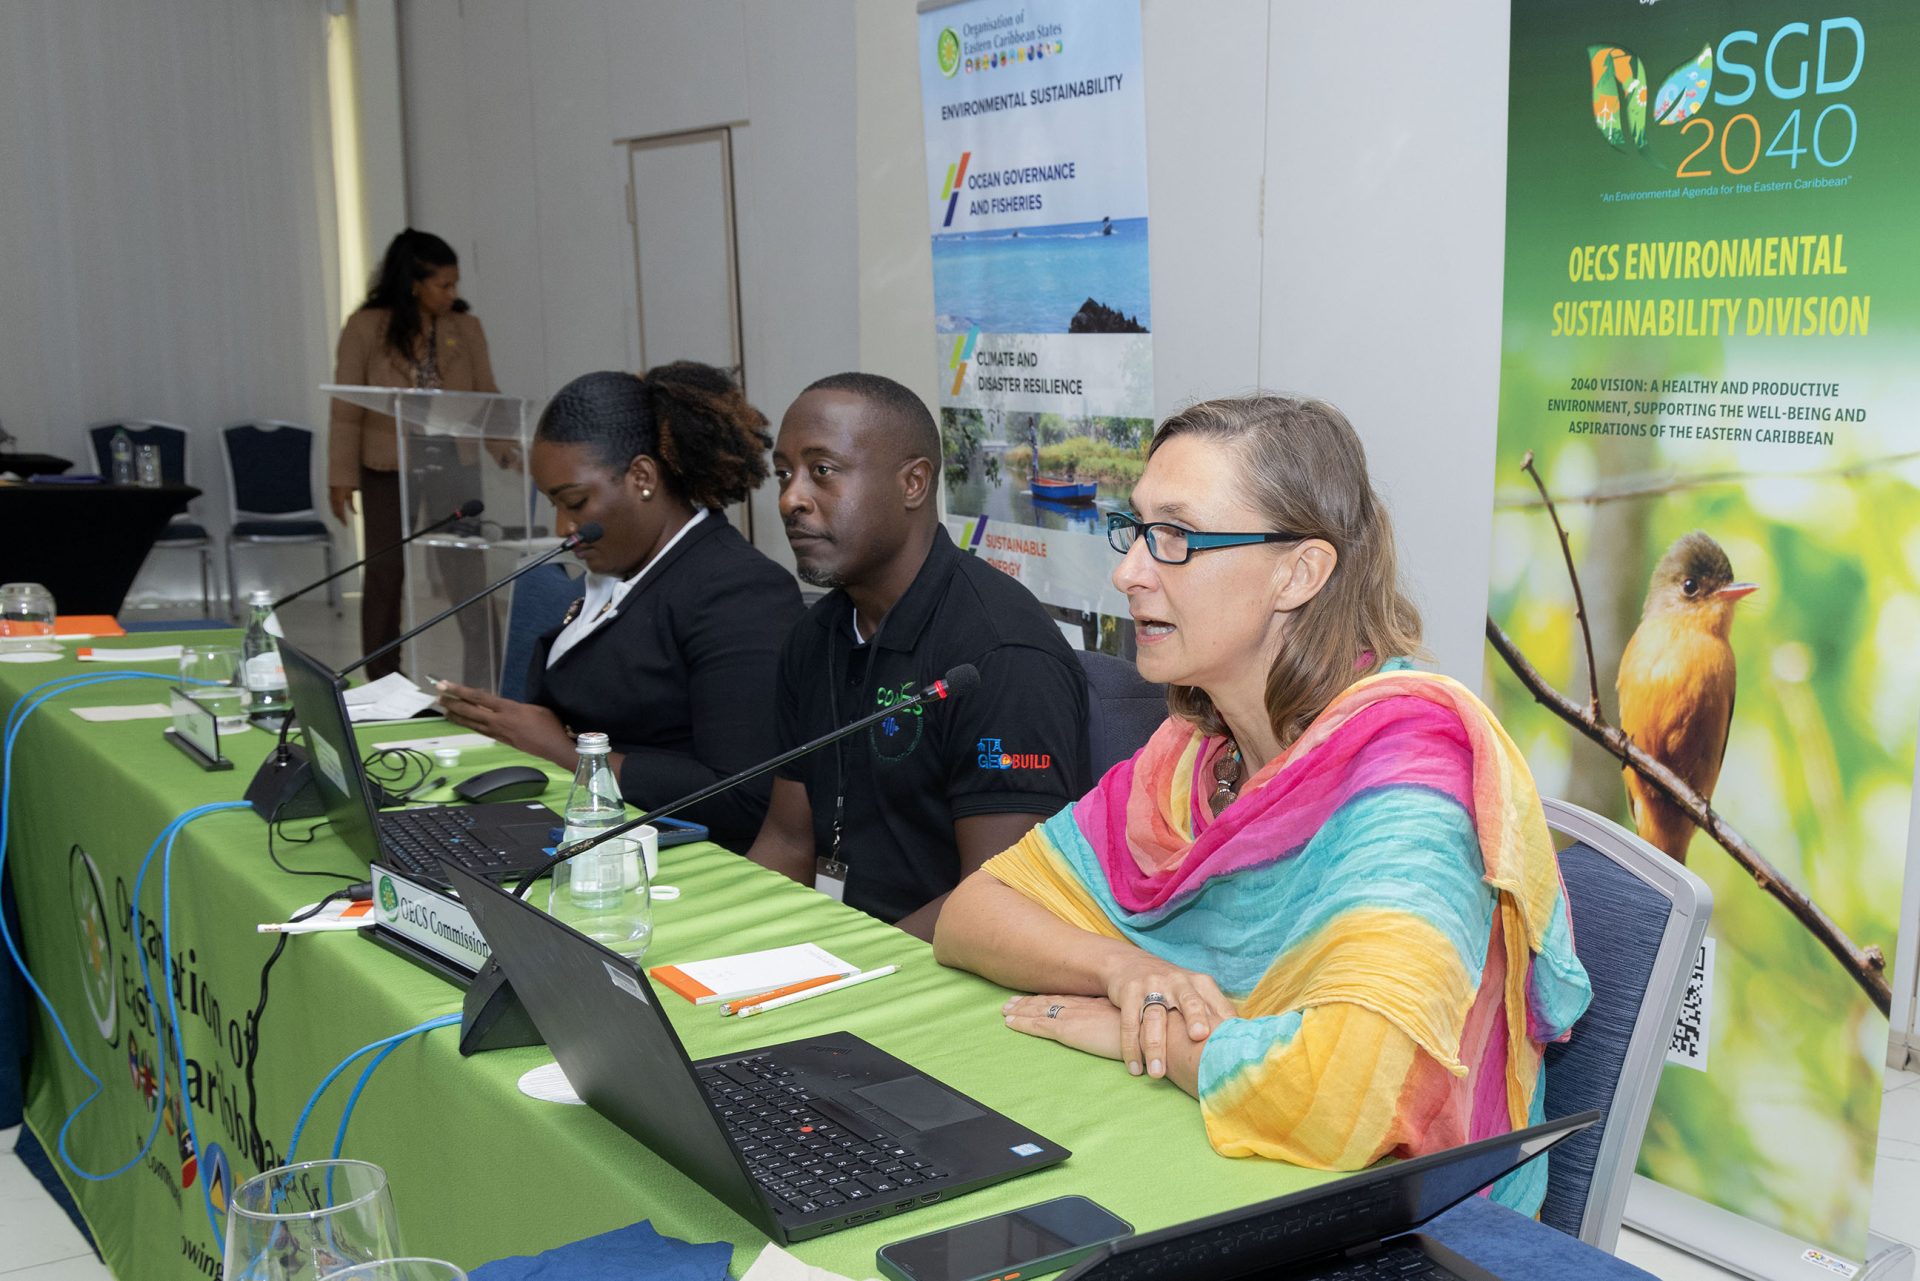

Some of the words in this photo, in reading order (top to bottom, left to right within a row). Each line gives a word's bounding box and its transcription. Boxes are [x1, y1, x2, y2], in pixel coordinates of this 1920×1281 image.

[963, 14, 1013, 39] Organisation
[1015, 8, 1025, 24] of
[963, 38, 991, 55] Eastern
[993, 29, 1035, 49] Caribbean
[1036, 23, 1063, 39] States
[1714, 16, 1865, 106] SGD
[941, 93, 1027, 121] ENVIRONMENTAL
[1030, 73, 1123, 105] SUSTAINABILITY
[1676, 103, 1857, 178] 2040
[968, 173, 1001, 190] OCEAN
[1002, 162, 1076, 186] GOVERNANCE
[969, 199, 990, 216] AND
[991, 194, 1043, 214] FISHERIES
[1615, 188, 1680, 202] Environmental
[1681, 186, 1718, 199] Agenda
[1720, 184, 1734, 195] for
[1736, 183, 1752, 193] the
[1753, 181, 1792, 193] Eastern
[1568, 243, 1620, 282] OECS
[1624, 233, 1848, 281] ENVIRONMENTAL
[1551, 297, 1743, 337] SUSTAINABILITY
[1745, 295, 1871, 337] DIVISION
[976, 351, 1015, 367] CLIMATE
[1016, 352, 1038, 367] AND
[978, 376, 1021, 392] DISASTER
[1023, 378, 1083, 395] RESILIENCE
[1570, 377, 1598, 391] 2040
[1600, 378, 1648, 392] VISION:
[1650, 379, 1659, 393] A
[1662, 380, 1718, 394] HEALTHY
[1720, 381, 1749, 395] AND
[1751, 381, 1840, 397] PRODUCTIVE
[1547, 398, 1631, 417] ENVIRONMENT,
[1633, 401, 1716, 417] SUPPORTING
[1719, 404, 1744, 418] THE
[1746, 404, 1831, 421] WELL-BEING
[1834, 407, 1867, 423] AND
[1568, 420, 1647, 437] ASPIRATIONS
[1649, 424, 1667, 438] OF
[1669, 425, 1693, 439] THE
[1695, 426, 1752, 442] EASTERN
[1755, 428, 1834, 446] CARIBBEAN
[985, 533, 1047, 558] SUSTAINABLE
[400, 897, 429, 930] OECS
[429, 910, 489, 958] Commission
